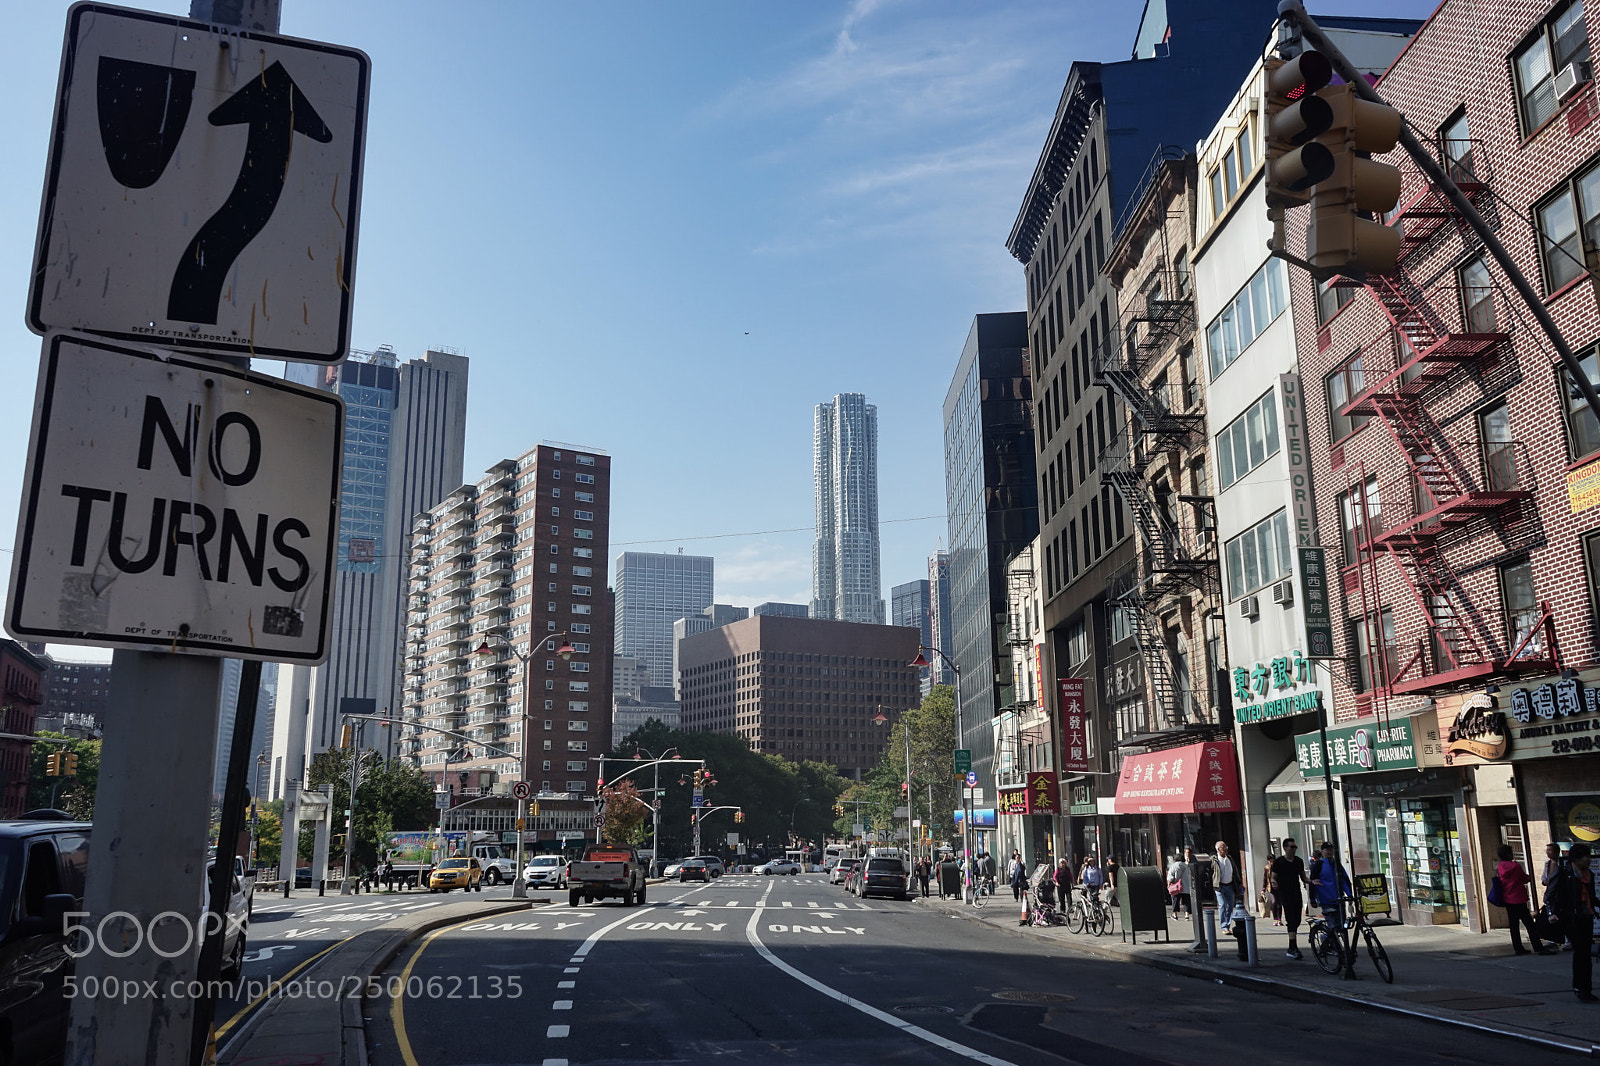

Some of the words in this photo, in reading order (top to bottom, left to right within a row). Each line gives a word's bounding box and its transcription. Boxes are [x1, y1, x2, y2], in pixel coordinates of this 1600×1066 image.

[132, 326, 155, 335] DEPT
[173, 331, 252, 345] TRANSPORTATION
[1283, 381, 1303, 466] UNITED
[137, 394, 262, 487] NO
[61, 483, 311, 592] TURNS
[1304, 550, 1323, 614] 維康西藥房
[125, 626, 146, 635] DEPT
[167, 630, 233, 643] TRANSPORTATION
[1233, 650, 1312, 702] 東方銀行
[1236, 704, 1262, 723] UNITED
[1263, 697, 1292, 717] ORIENT
[1294, 691, 1318, 711] BANK
[1067, 699, 1083, 760] 永發大廈
[1376, 726, 1407, 743] BUY-RITE
[1554, 720, 1590, 736] BAKERY
[1376, 745, 1413, 762] PHARMACY
[1032, 775, 1053, 808] 金泰
[1350, 799, 1361, 811] ATM
[1360, 877, 1382, 888] WU
[462, 921, 584, 931] ONLY
[626, 921, 728, 932] ONLY
[768, 923, 866, 935] ONLY
